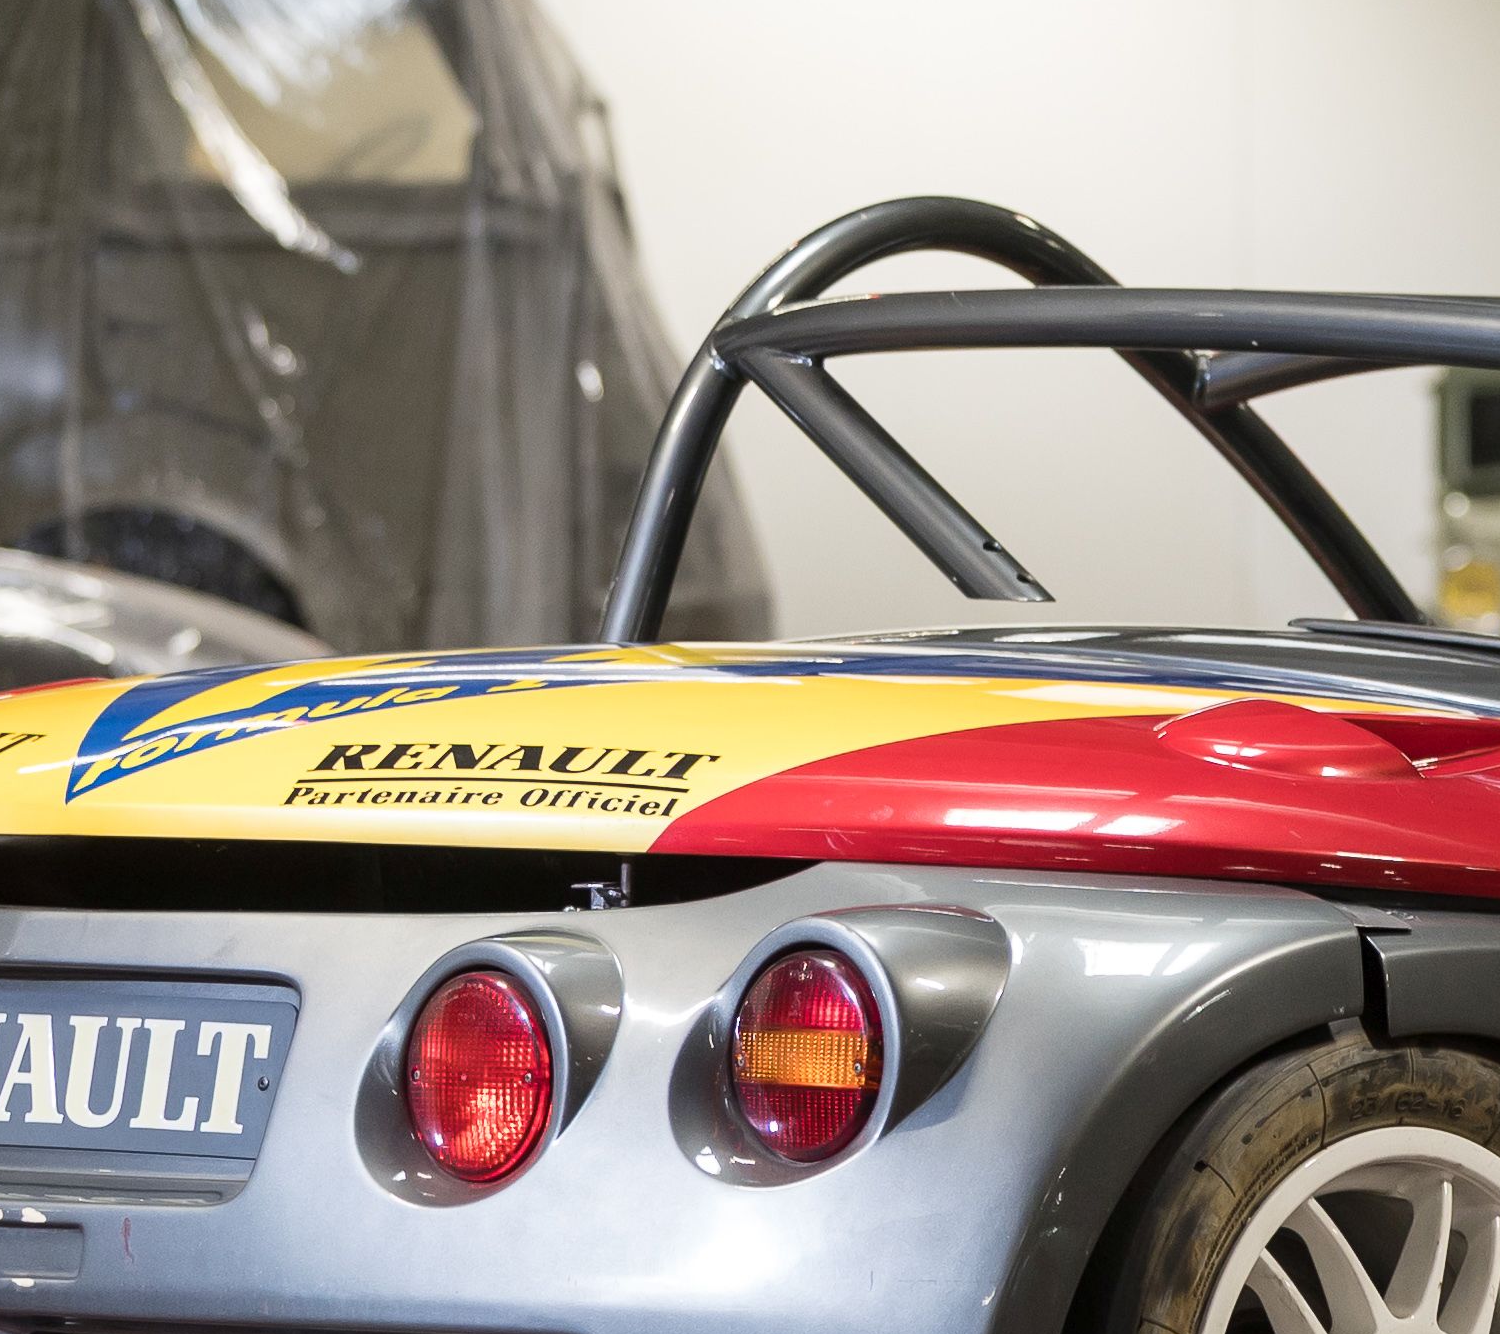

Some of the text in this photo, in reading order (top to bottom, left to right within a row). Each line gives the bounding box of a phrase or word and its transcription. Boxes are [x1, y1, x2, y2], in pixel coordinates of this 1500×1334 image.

[73, 685, 460, 793] Formula
[307, 743, 721, 780] RENAULT
[283, 785, 680, 818] Partenaire Officiel
